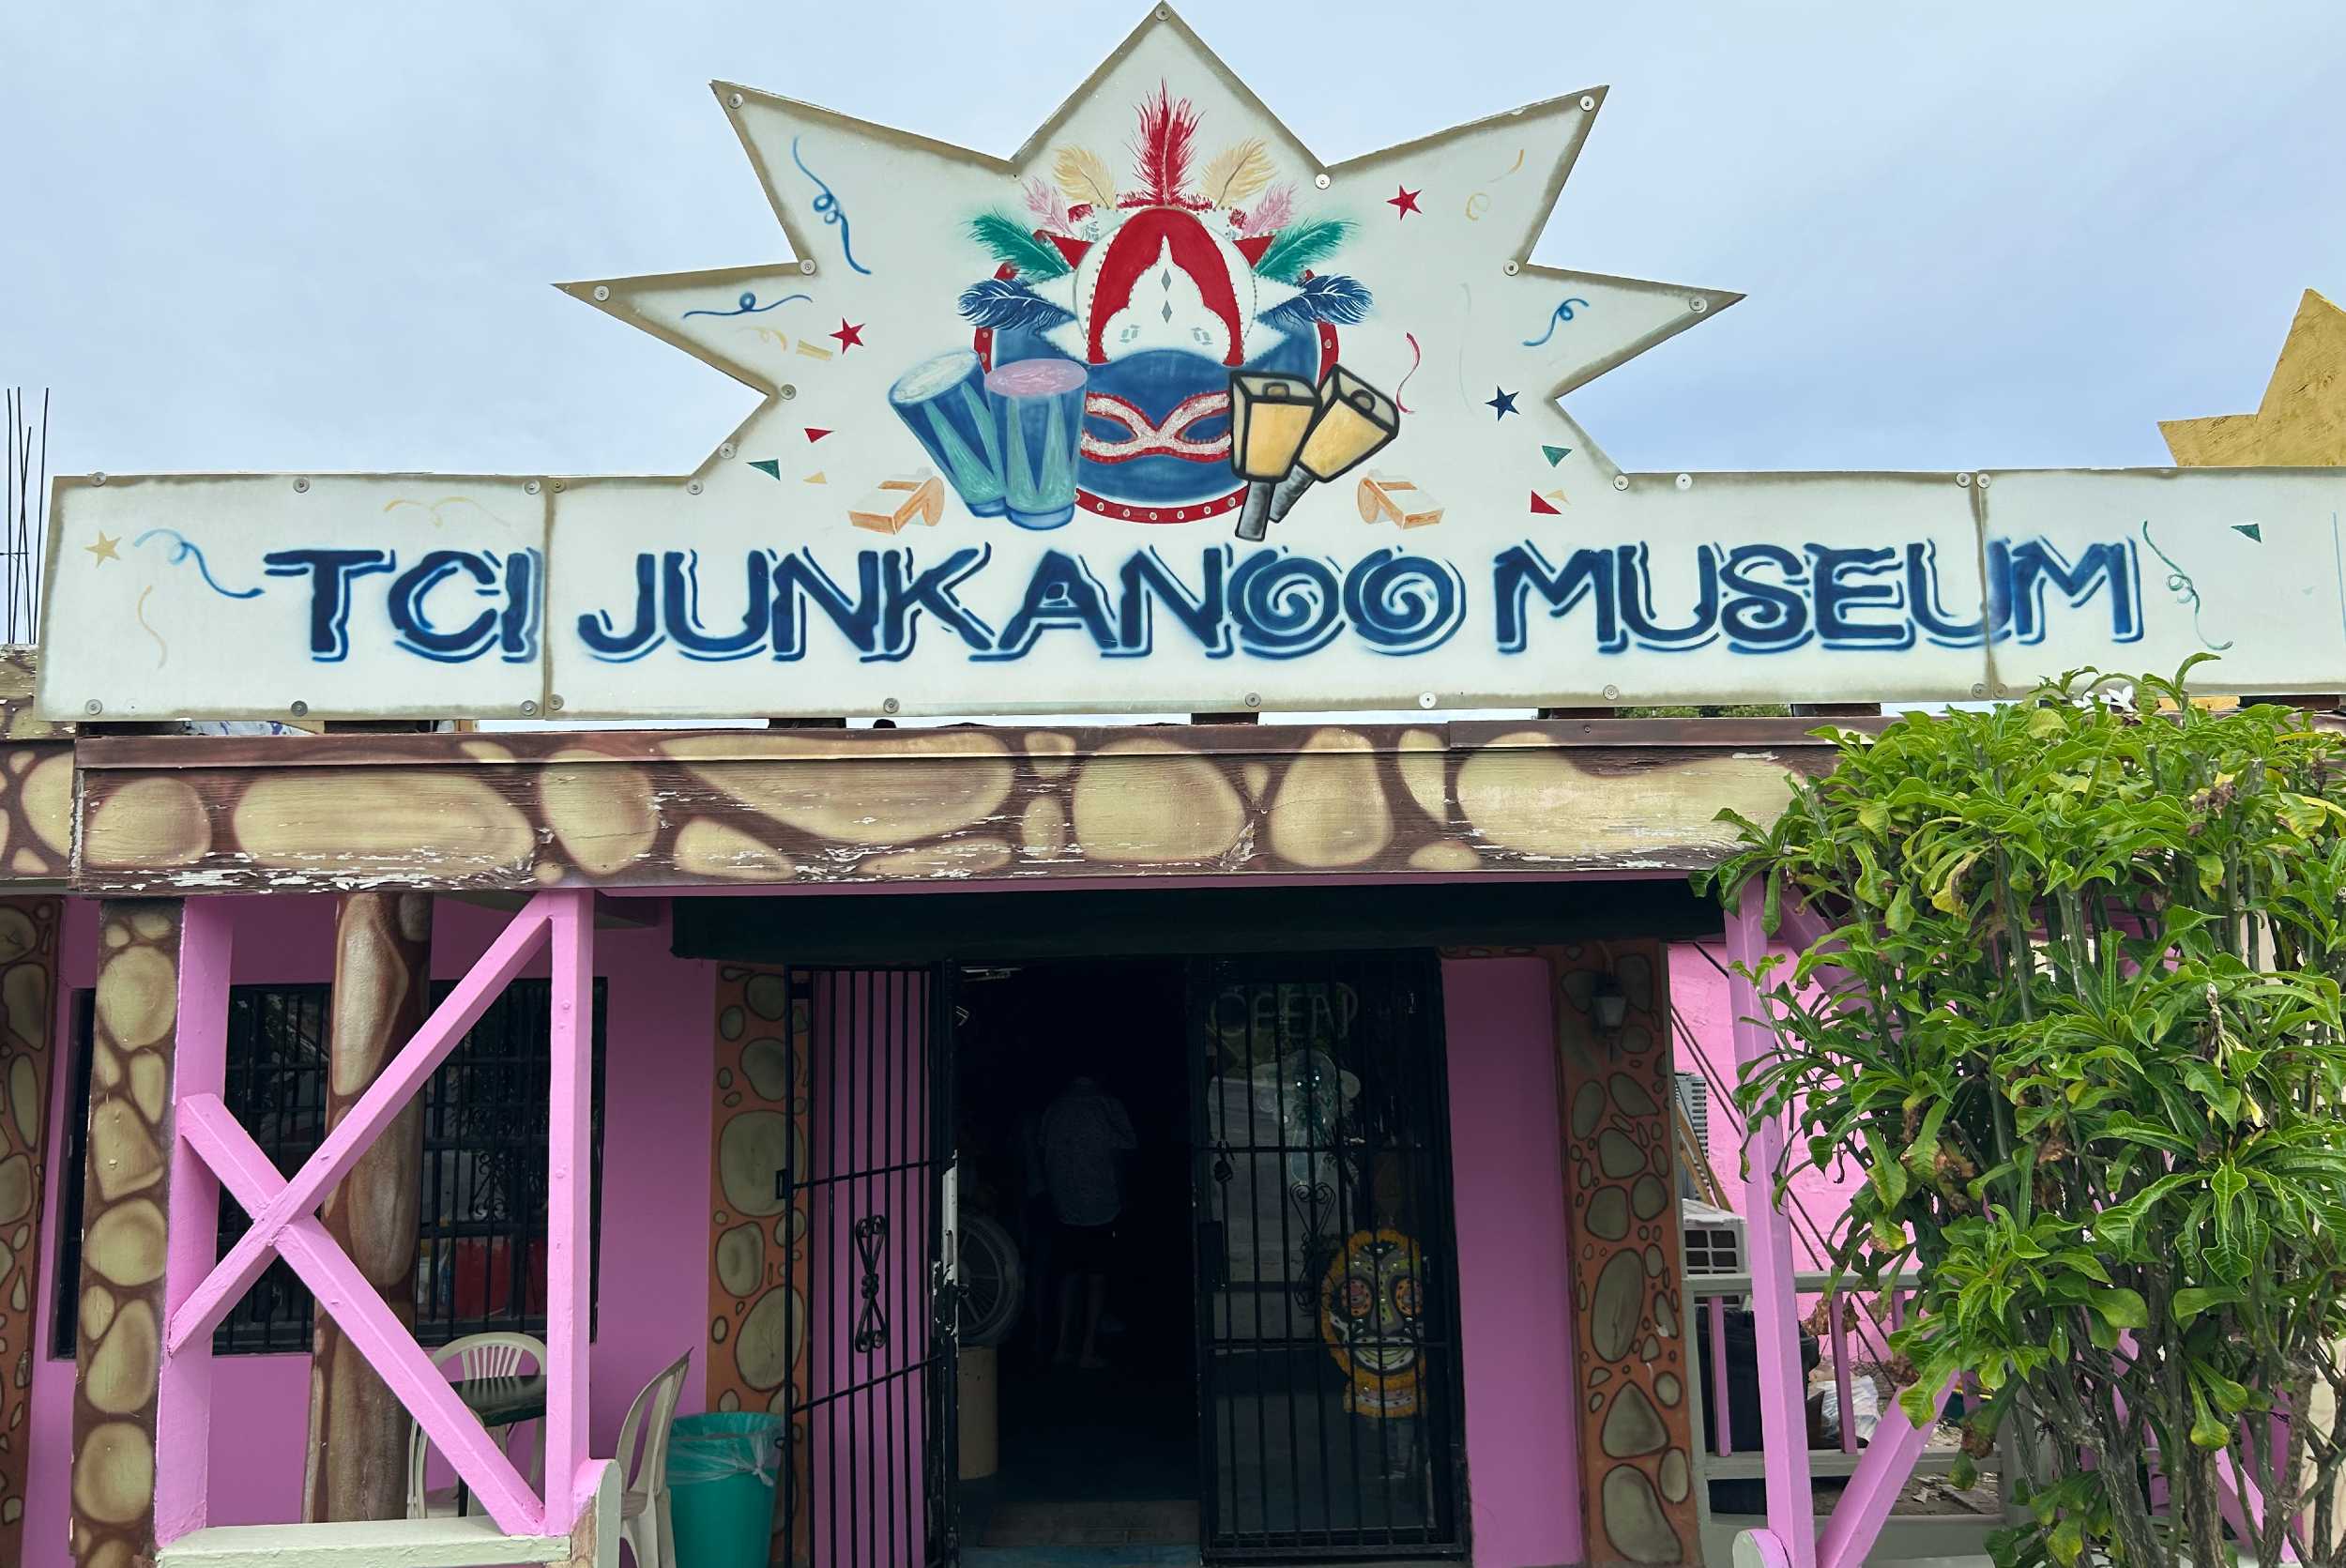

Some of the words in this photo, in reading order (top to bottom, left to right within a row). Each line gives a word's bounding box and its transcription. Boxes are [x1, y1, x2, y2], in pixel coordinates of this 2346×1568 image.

[265, 547, 543, 663] TCI
[576, 541, 1467, 662] JUNKANOO
[1493, 536, 2145, 654] MUSEUM
